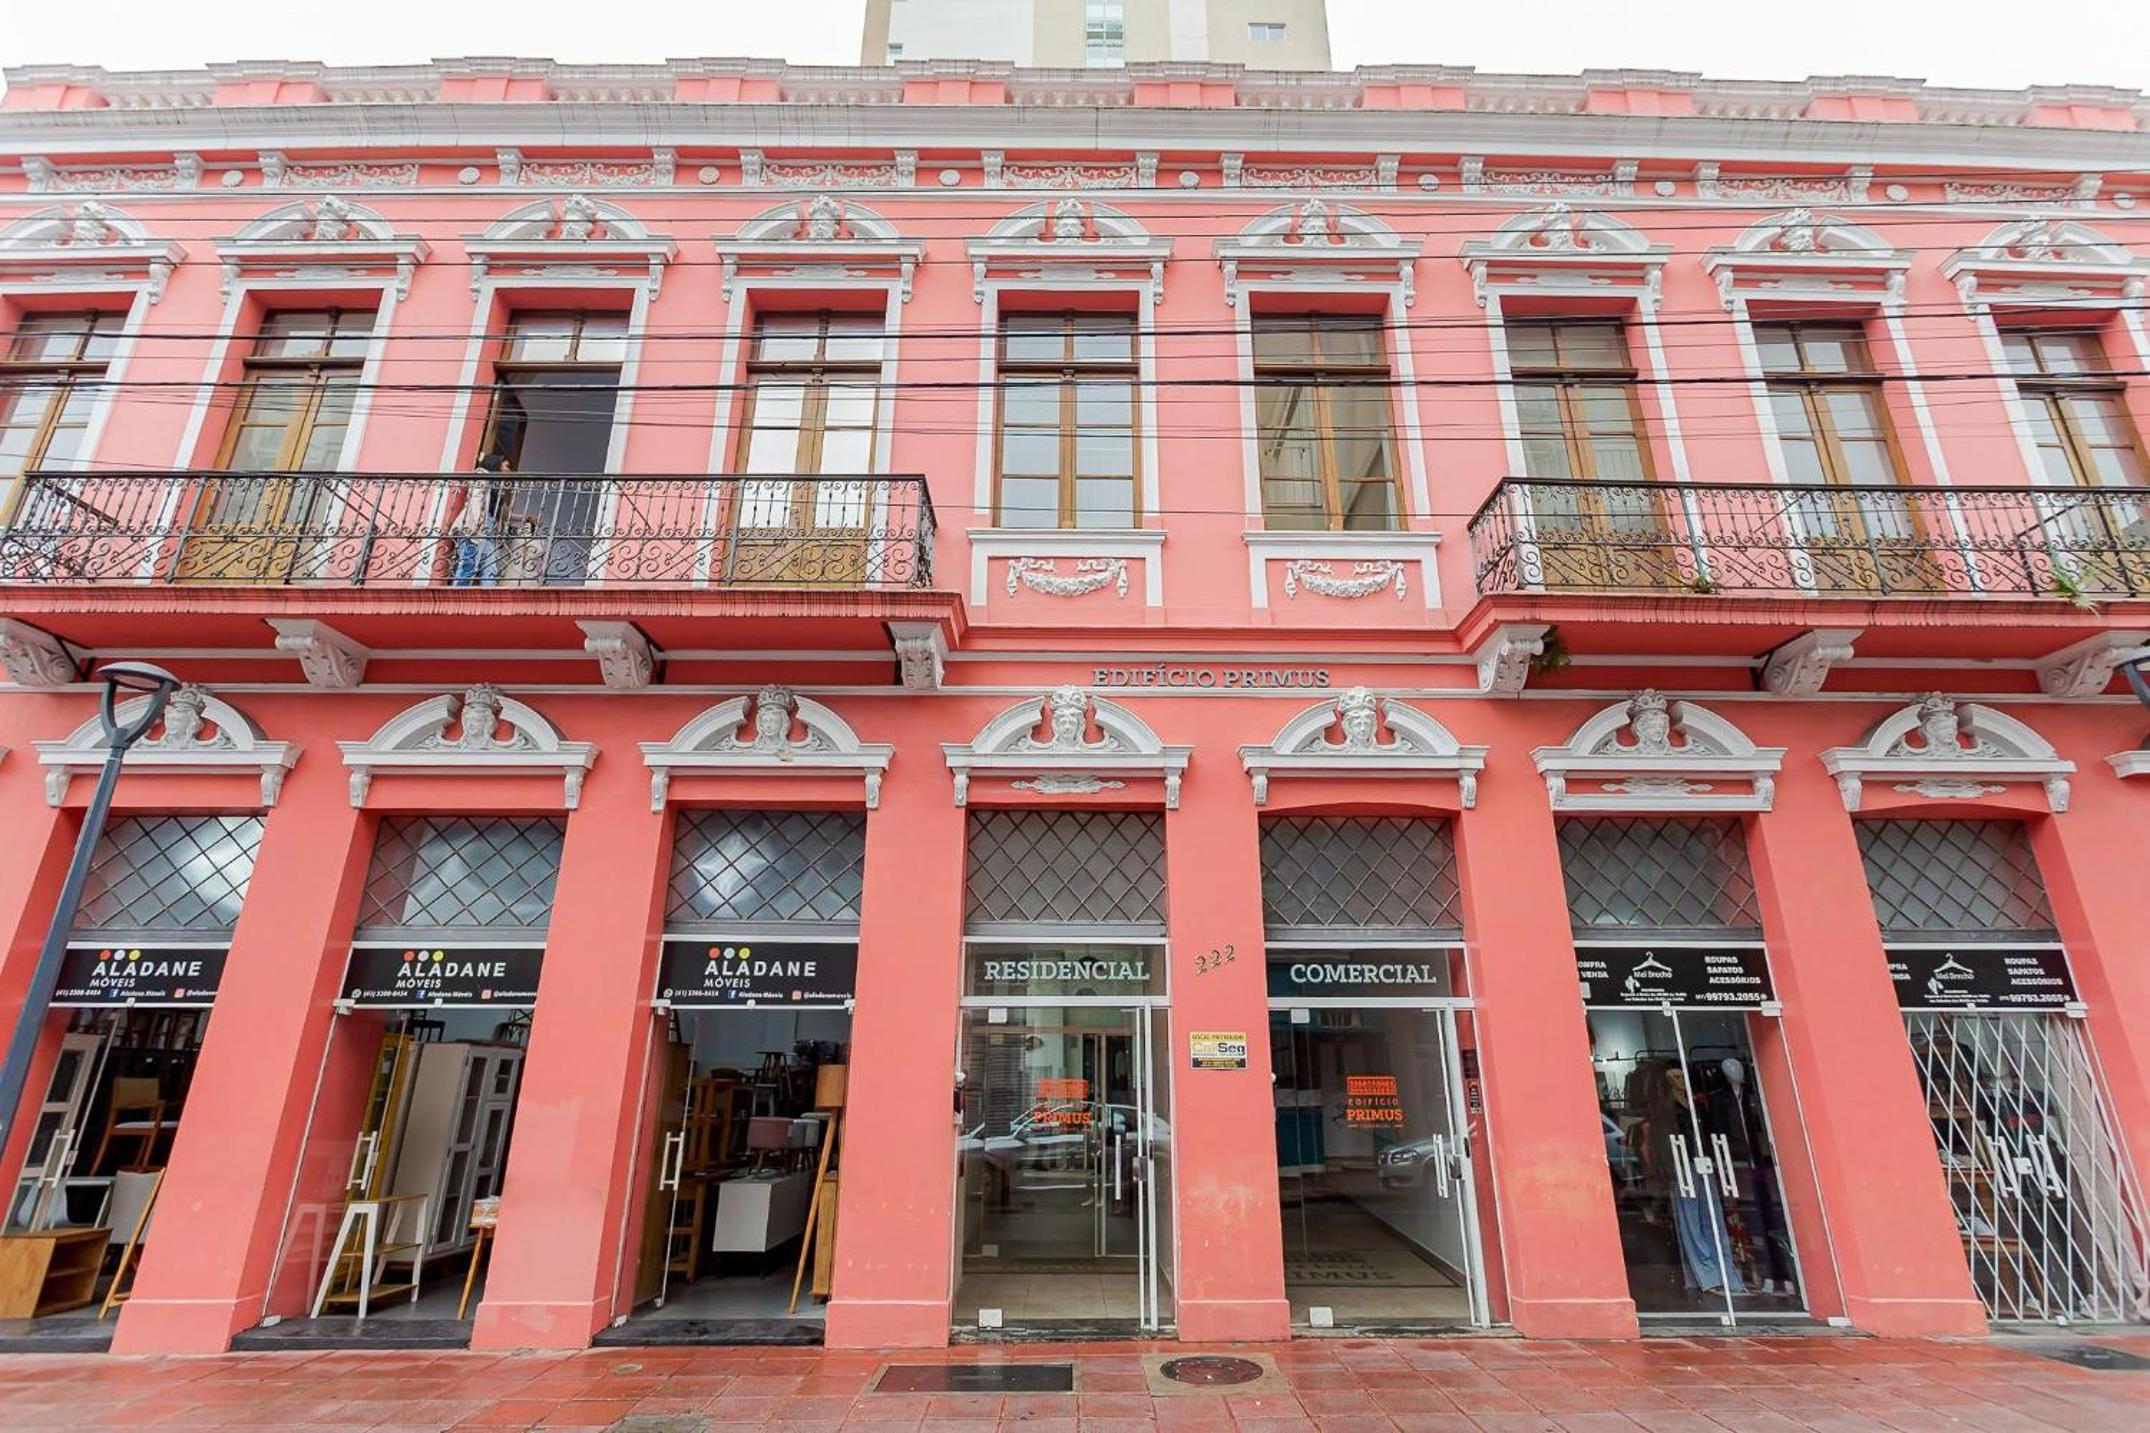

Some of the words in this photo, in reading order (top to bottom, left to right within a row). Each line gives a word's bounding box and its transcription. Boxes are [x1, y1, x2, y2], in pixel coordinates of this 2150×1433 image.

[1092, 663, 1216, 688] EDIFÍCIO
[1223, 668, 1331, 688] PRIMUS
[1193, 944, 1235, 974] 222
[1704, 956, 1738, 964] ROUPAS
[91, 961, 203, 977] ALADANE
[397, 962, 507, 977] ALADANE
[704, 960, 817, 976] ALADANE
[984, 960, 1150, 981] RESIDENCIAL
[1290, 963, 1437, 984] COMERCIAL
[1707, 966, 1744, 974] SAPATOS
[89, 977, 136, 988] MÓVEIS
[396, 978, 442, 988] MÓVEIS
[703, 977, 750, 988] MÓVEIS
[1347, 1109, 1403, 1121] PRIMUS
